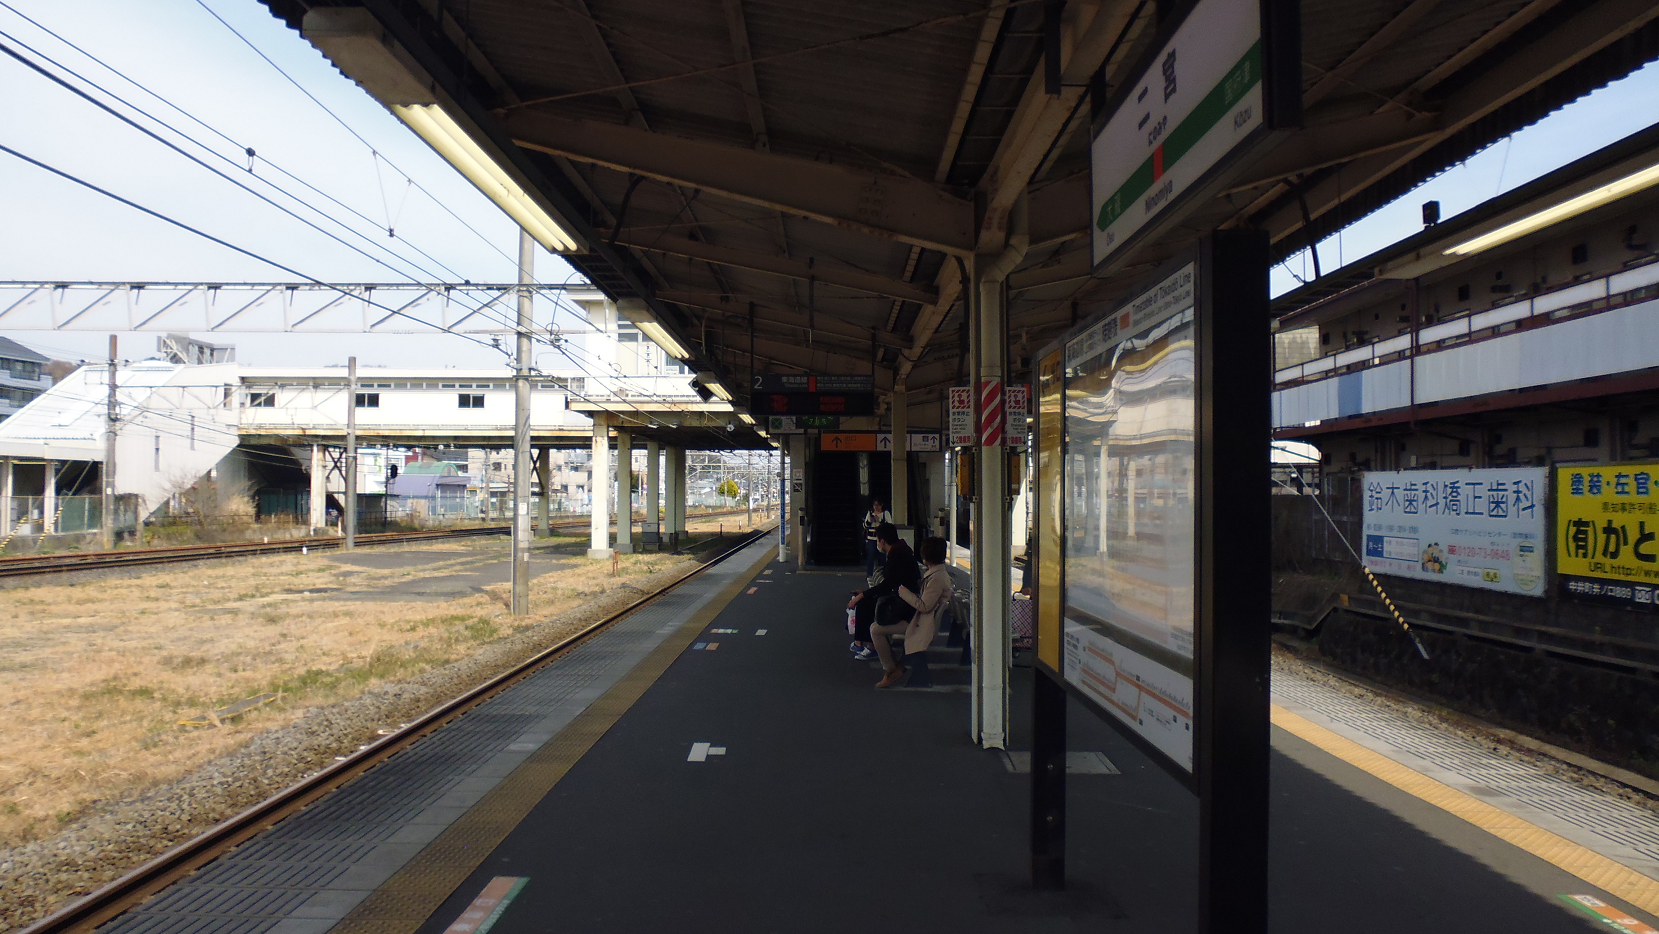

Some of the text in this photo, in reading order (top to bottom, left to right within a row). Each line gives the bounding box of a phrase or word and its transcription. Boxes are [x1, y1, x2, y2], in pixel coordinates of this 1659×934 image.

[1138, 48, 1177, 131] 二宮
[1147, 115, 1168, 147] にのみや
[1145, 179, 1173, 214] Ninomiya
[1179, 272, 1192, 288] Line
[754, 375, 763, 389] 2
[1367, 479, 1537, 519] 鈴木歯科矯正歯科
[1589, 561, 1608, 575] URL
